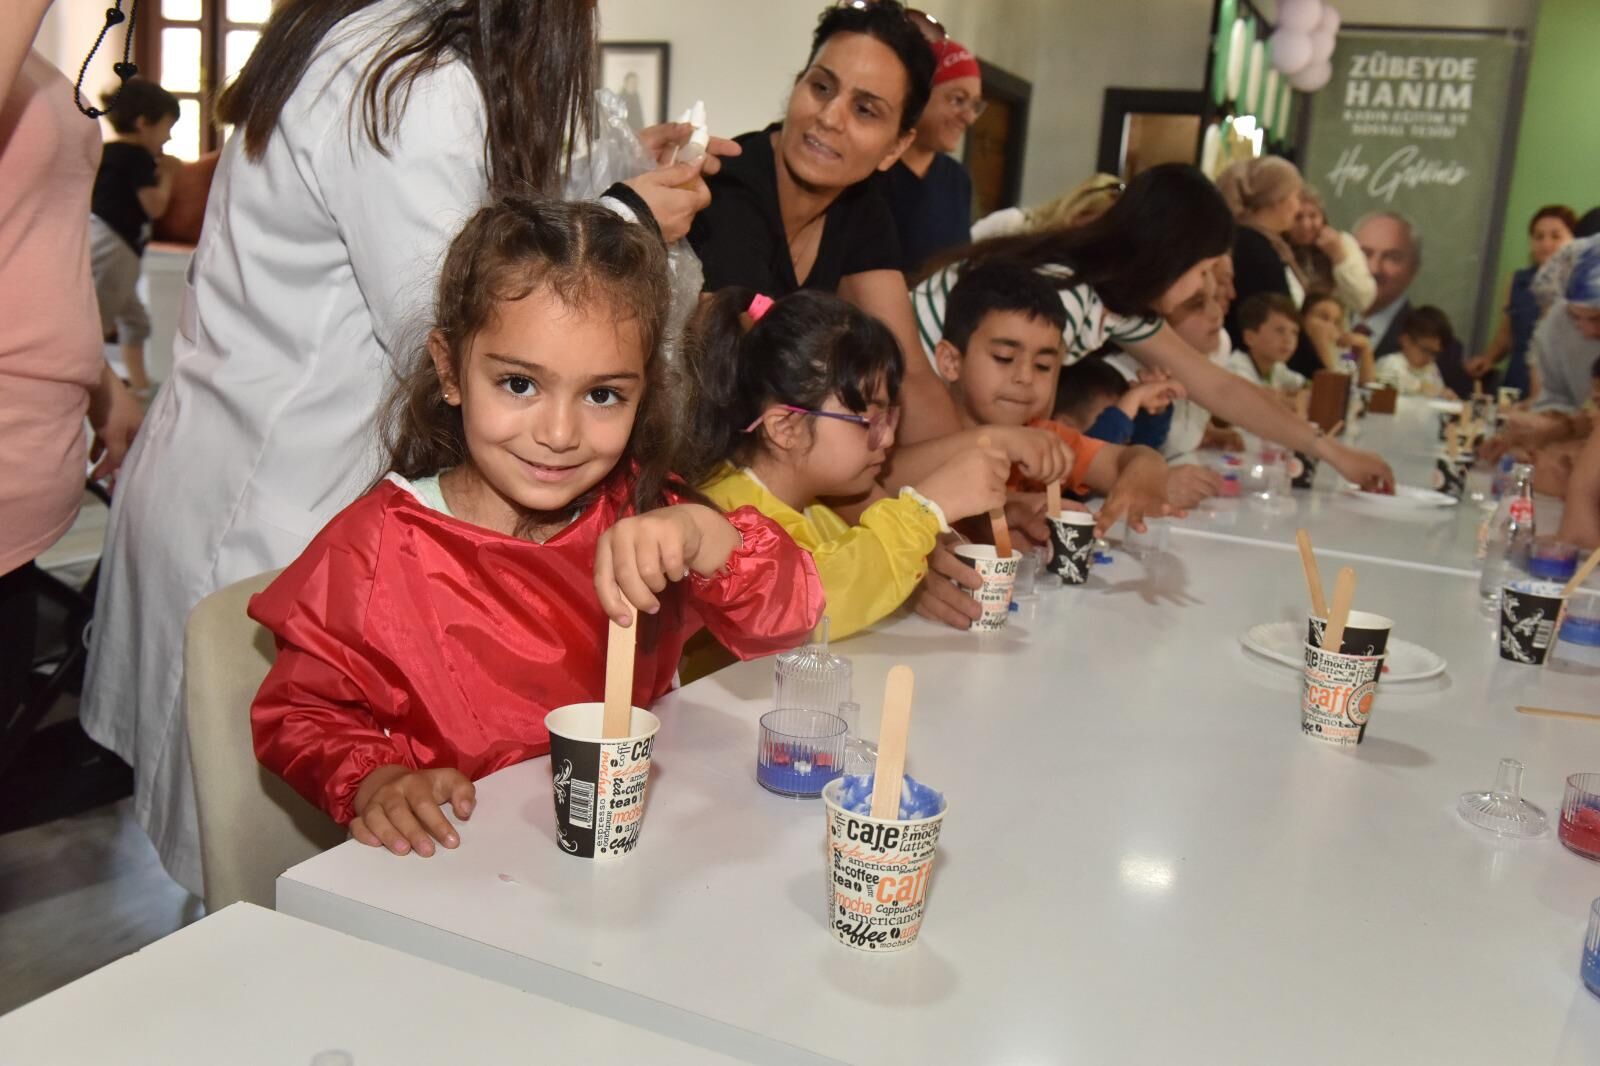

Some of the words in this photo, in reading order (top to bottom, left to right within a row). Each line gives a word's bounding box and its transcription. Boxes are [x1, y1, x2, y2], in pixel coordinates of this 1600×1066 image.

[1349, 51, 1477, 80] ZÜBEYDE
[1345, 80, 1472, 109] HANIM
[609, 798, 631, 809] tea
[848, 856, 908, 873] americano
[833, 870, 852, 889] tea
[845, 865, 880, 885] coffee
[835, 892, 873, 915] mocha
[848, 908, 918, 927] americano
